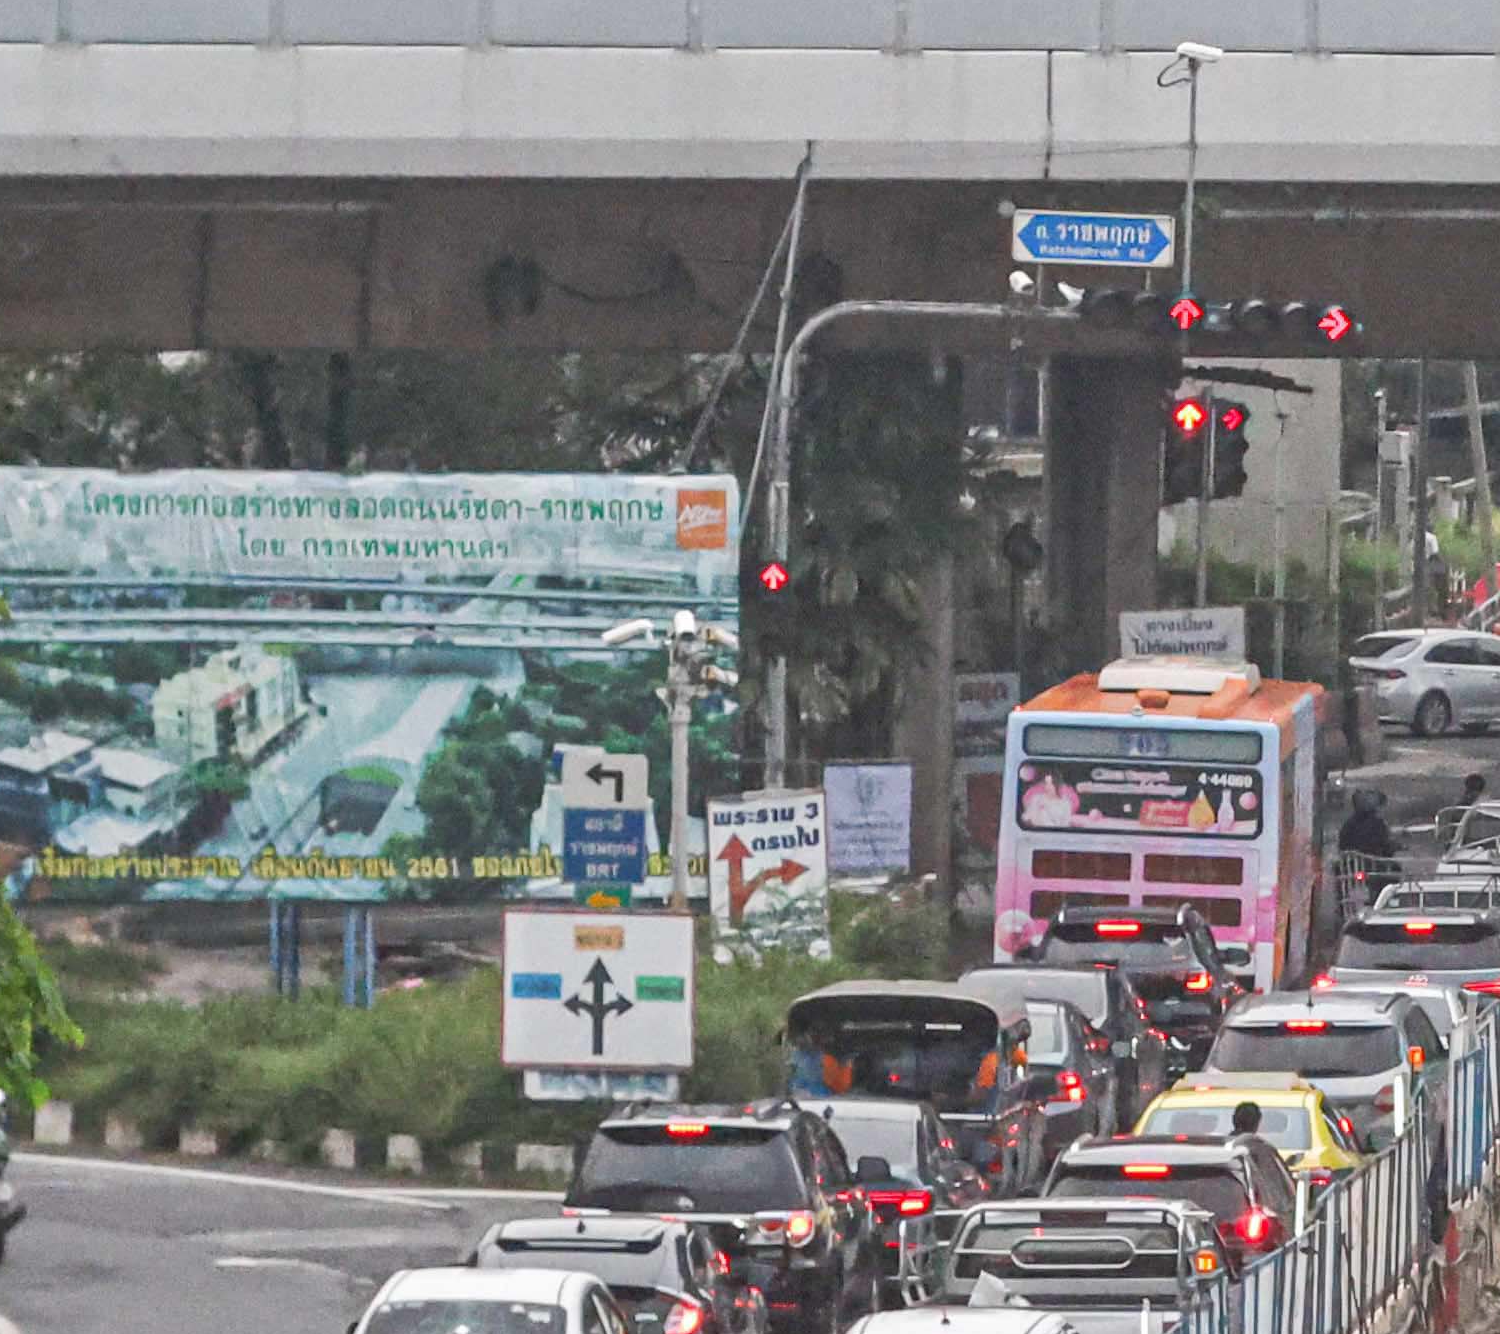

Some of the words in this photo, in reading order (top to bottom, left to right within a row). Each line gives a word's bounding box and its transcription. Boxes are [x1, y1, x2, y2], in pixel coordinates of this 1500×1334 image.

[238, 527, 286, 558] โดย
[713, 807, 795, 827] พระราม
[804, 801, 820, 820] 3
[750, 824, 820, 852] ตรงไป
